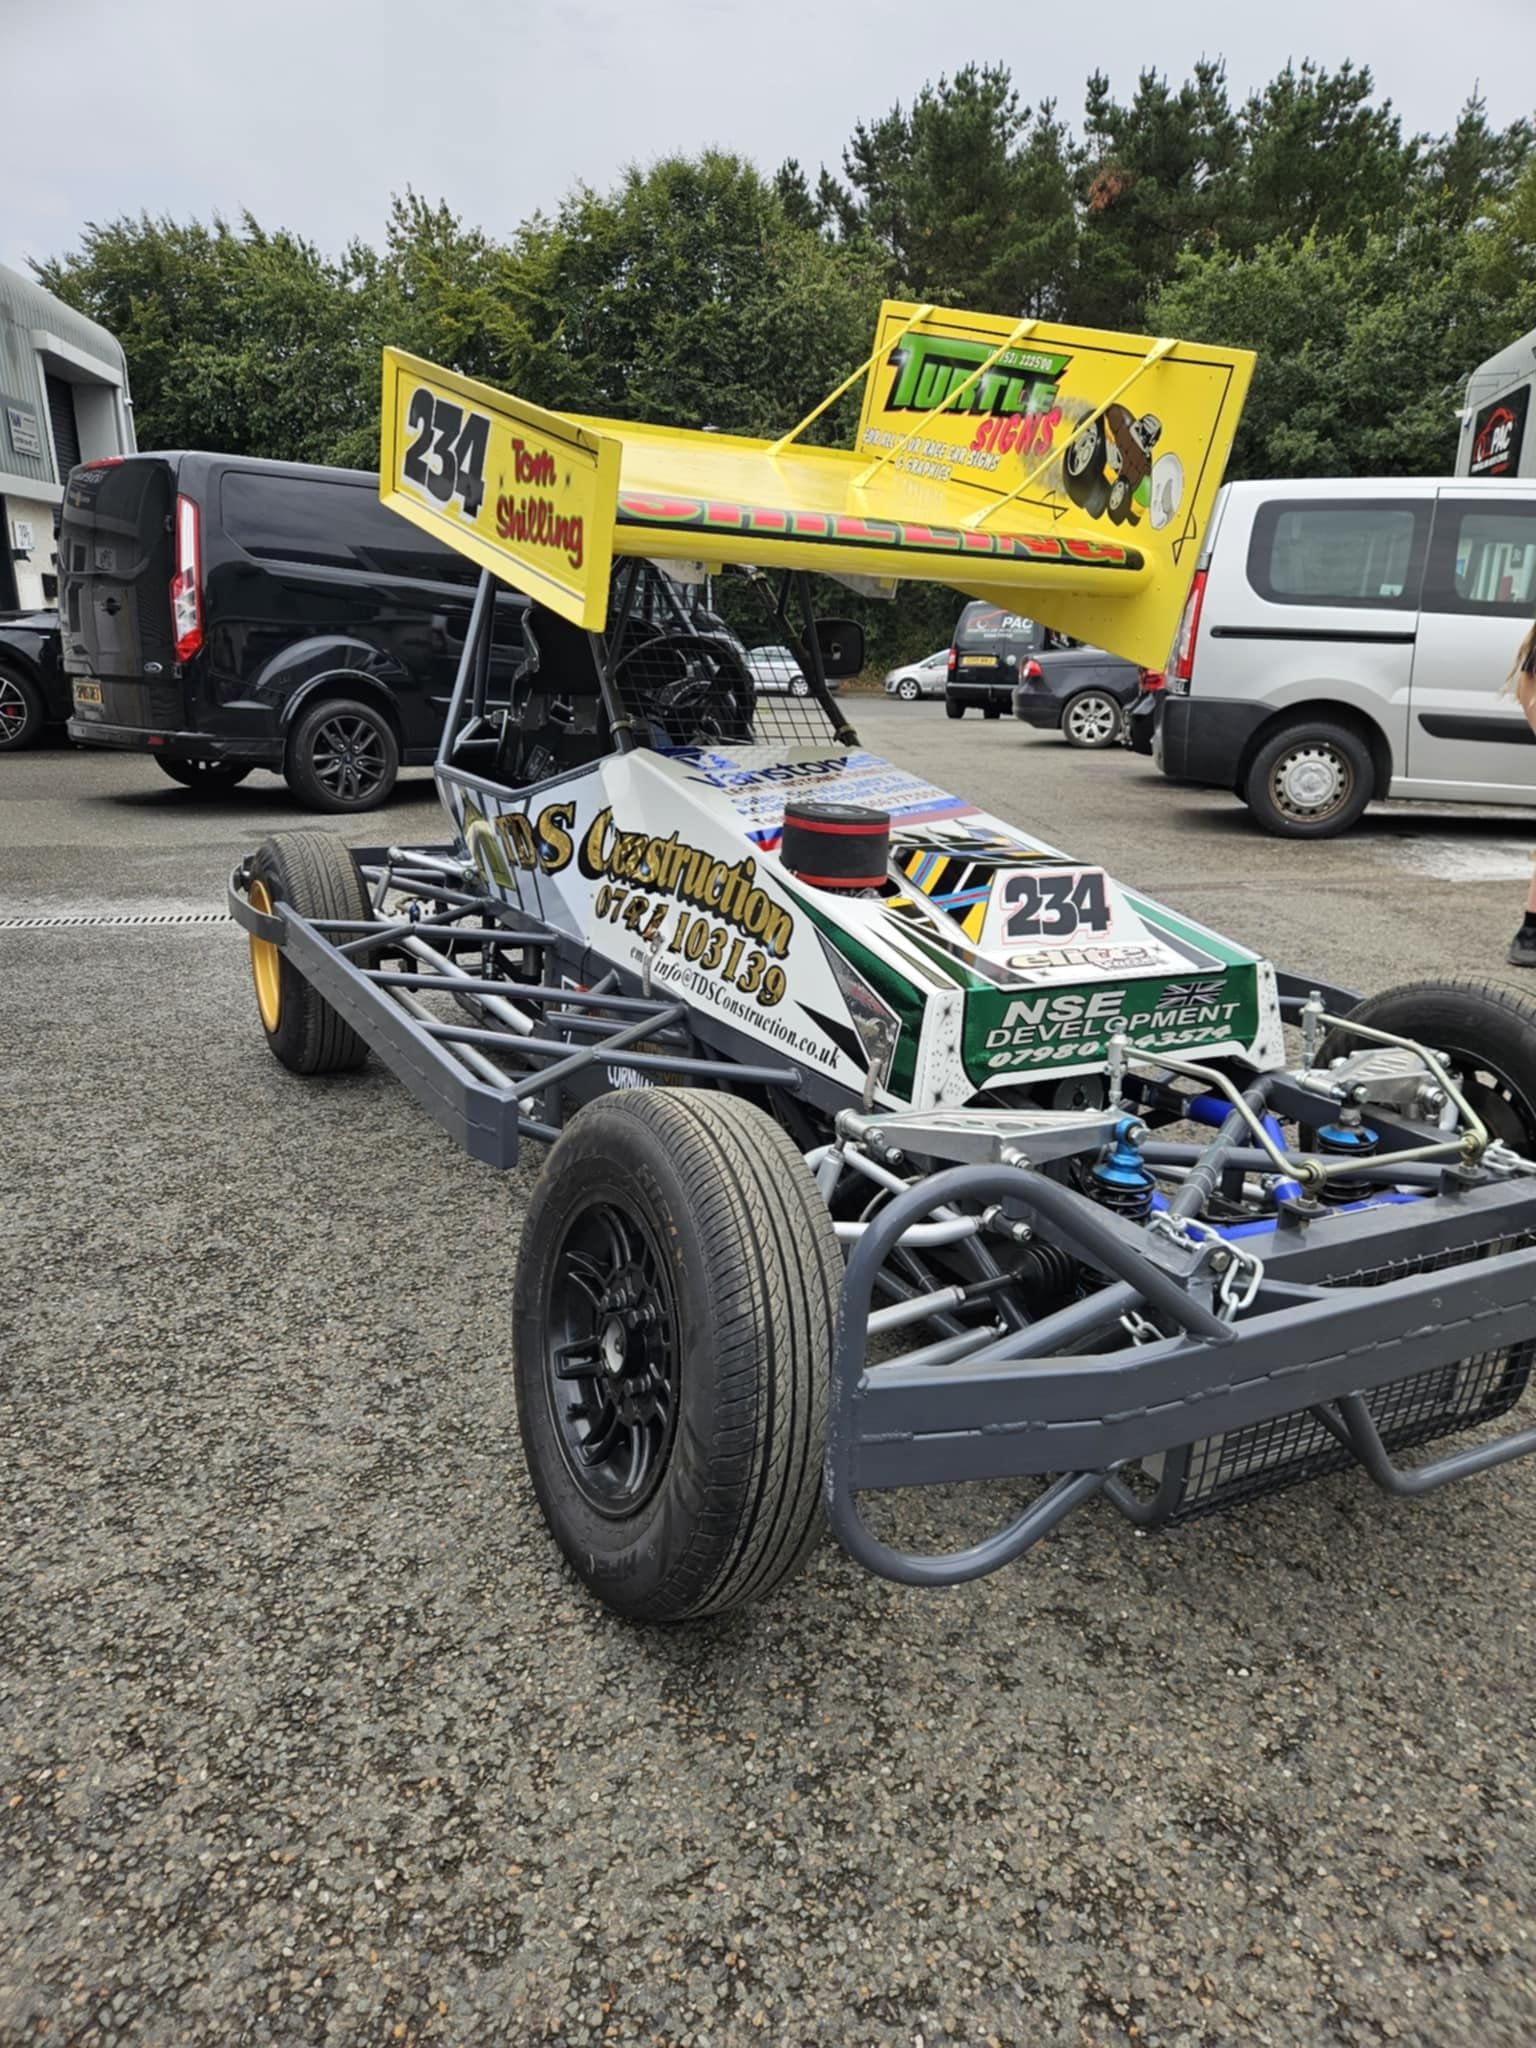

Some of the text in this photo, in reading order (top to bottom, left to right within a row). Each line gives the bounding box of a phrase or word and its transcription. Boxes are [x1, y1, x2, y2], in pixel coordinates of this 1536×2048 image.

[886, 332, 1073, 415] TURTLE
[404, 387, 490, 519] 234
[922, 438, 947, 460] RACE
[948, 446, 967, 465] CAR
[967, 449, 1001, 472] SIGNS
[971, 407, 1062, 455] SIGNS
[1490, 421, 1512, 455] PAC
[511, 437, 557, 488] Tom
[905, 457, 953, 482] GRAPHICS
[495, 494, 583, 570] Shilling
[1002, 615, 1035, 629] PAC
[1005, 872, 1111, 938] 234
[666, 911, 787, 1007] 103139
[653, 955, 841, 1069] info@TDSConstruction.co.uk
[985, 1003, 1240, 1049] DEVELOPMENT
[1002, 990, 1127, 1028] NSE
[987, 1025, 1233, 1068] 07980 43574
